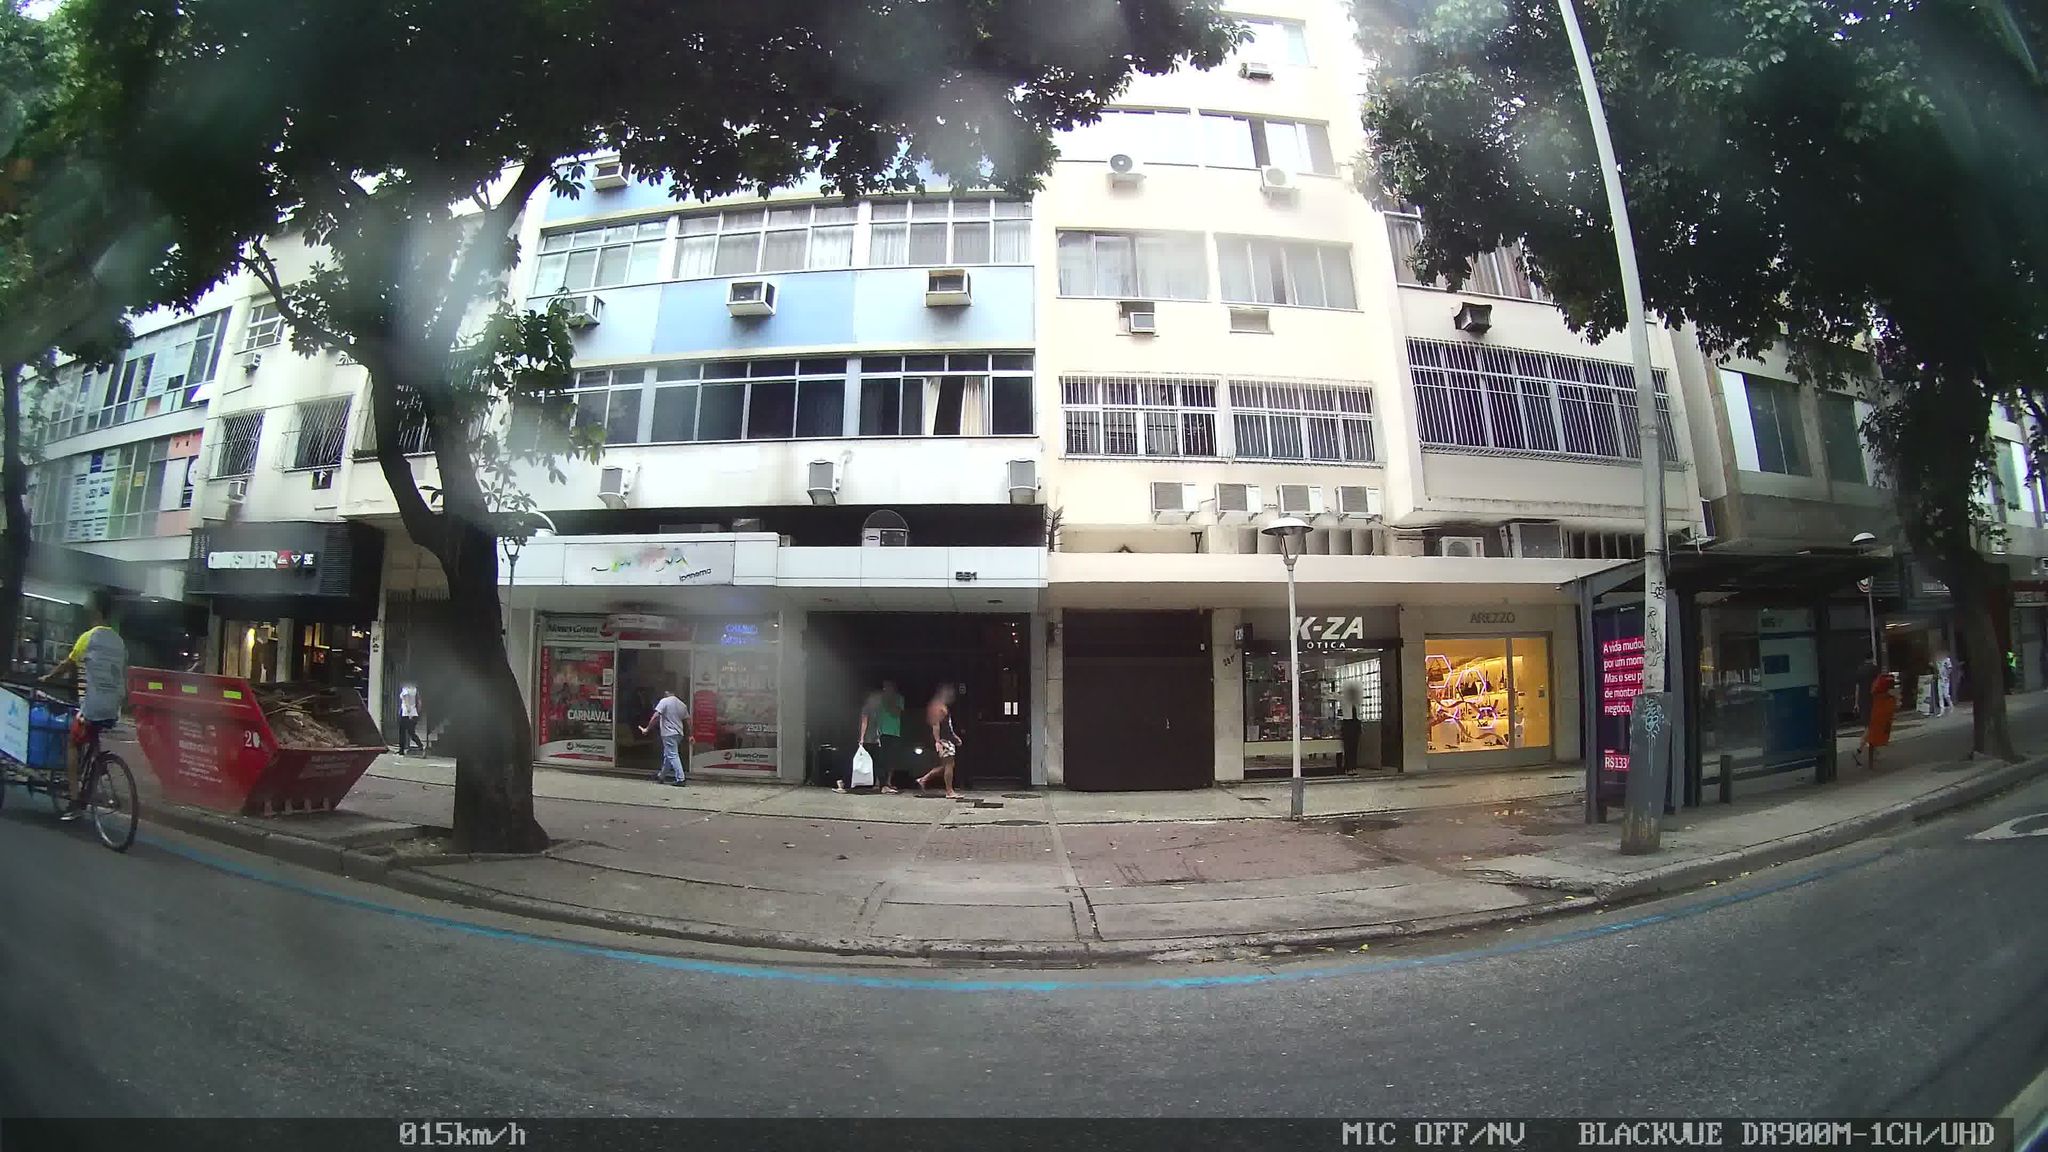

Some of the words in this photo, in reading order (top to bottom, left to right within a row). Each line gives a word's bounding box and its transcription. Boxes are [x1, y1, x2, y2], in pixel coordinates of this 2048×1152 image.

[1470, 611, 1516, 624] AREZZO
[1609, 640, 1621, 652] vida
[1615, 658, 1625, 667] um
[1626, 656, 1644, 666] mom
[1605, 672, 1618, 683] Mas
[1624, 673, 1636, 682] seu
[1605, 687, 1613, 698] de
[1614, 687, 1637, 698] montar
[567, 709, 612, 723] CARNAVAL
